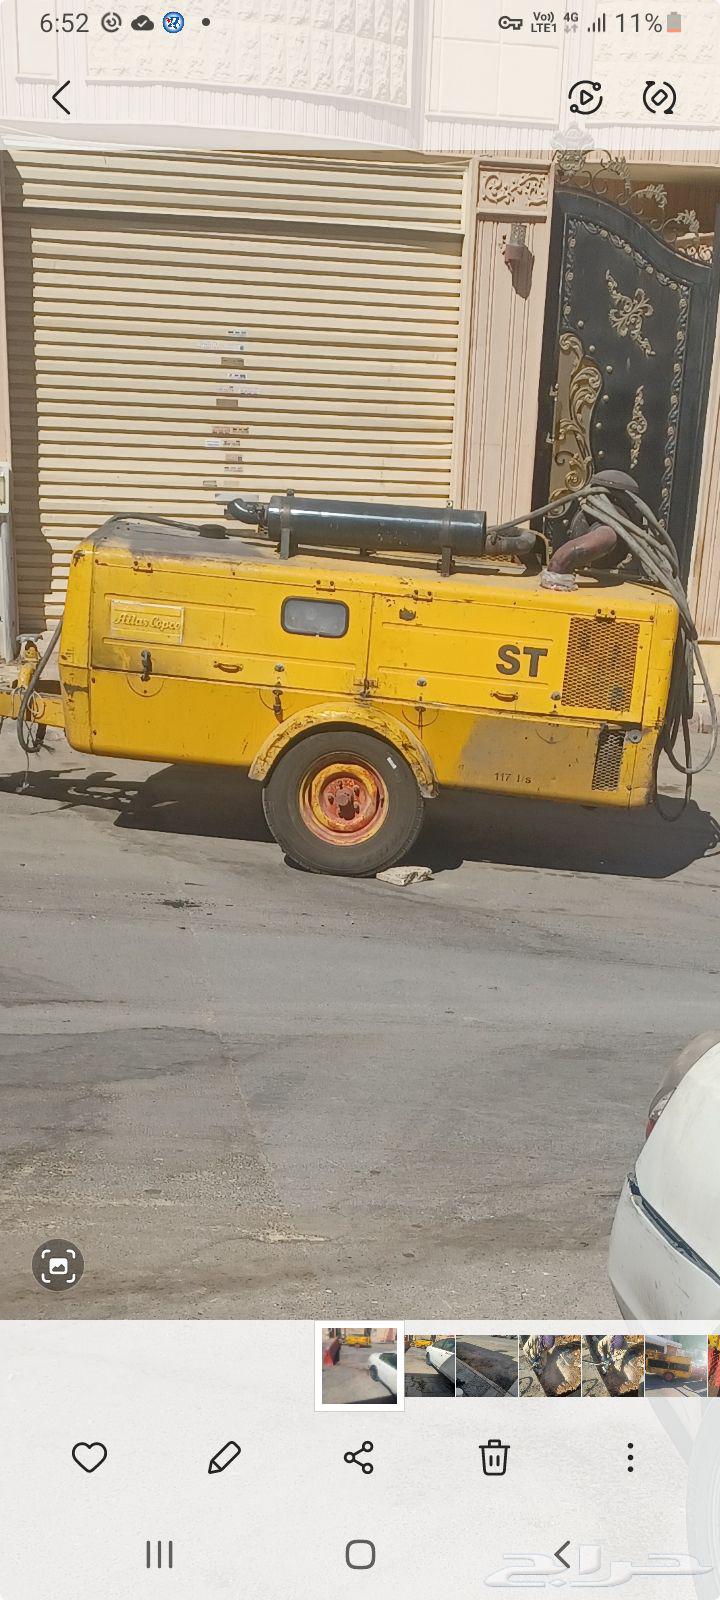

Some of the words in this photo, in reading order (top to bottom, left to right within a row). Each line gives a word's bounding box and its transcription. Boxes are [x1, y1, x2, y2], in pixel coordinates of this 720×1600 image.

[114, 612, 149, 628] Atlas
[149, 615, 180, 632] Copco
[495, 644, 549, 678] ST
[494, 772, 512, 782] 117
